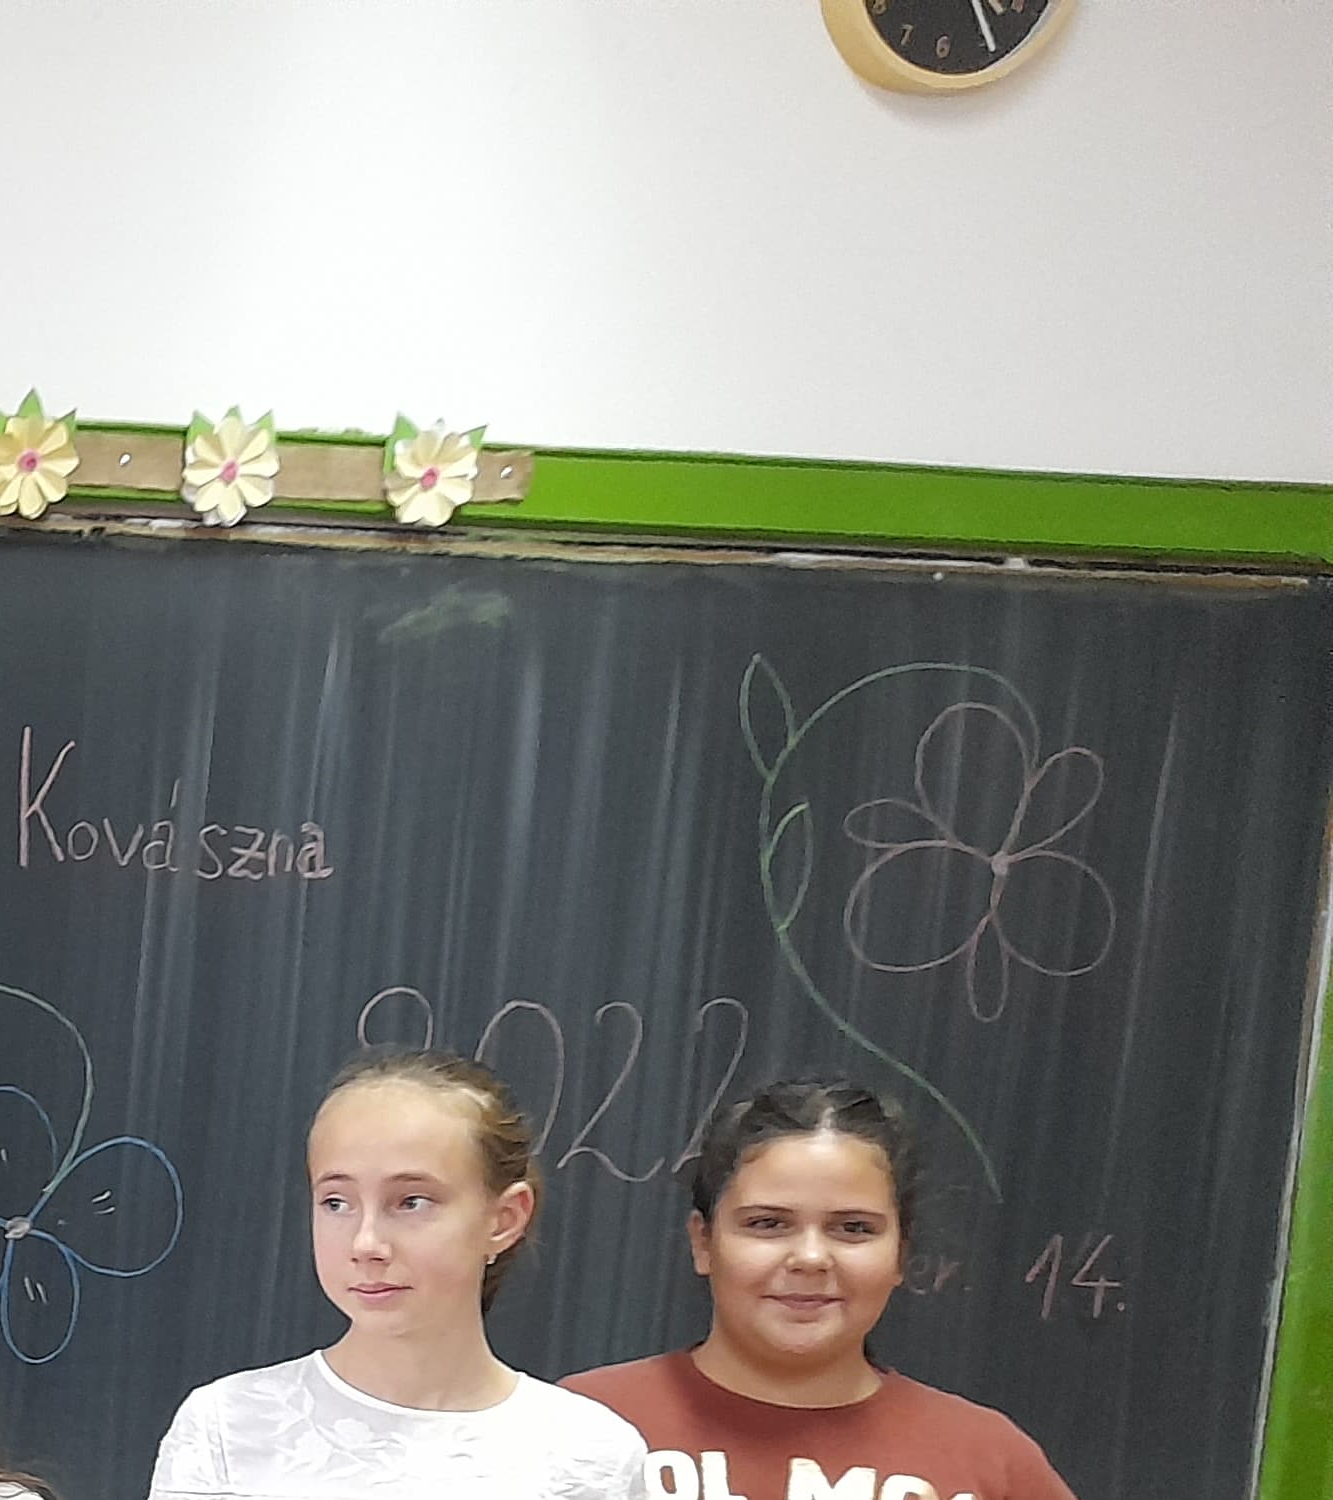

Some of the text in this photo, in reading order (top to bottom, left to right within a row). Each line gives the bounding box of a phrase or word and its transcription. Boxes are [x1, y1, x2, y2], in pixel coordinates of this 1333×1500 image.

[900, 24, 914, 46] 7
[936, 35, 950, 58] 6
[18, 726, 333, 880] Kovászna
